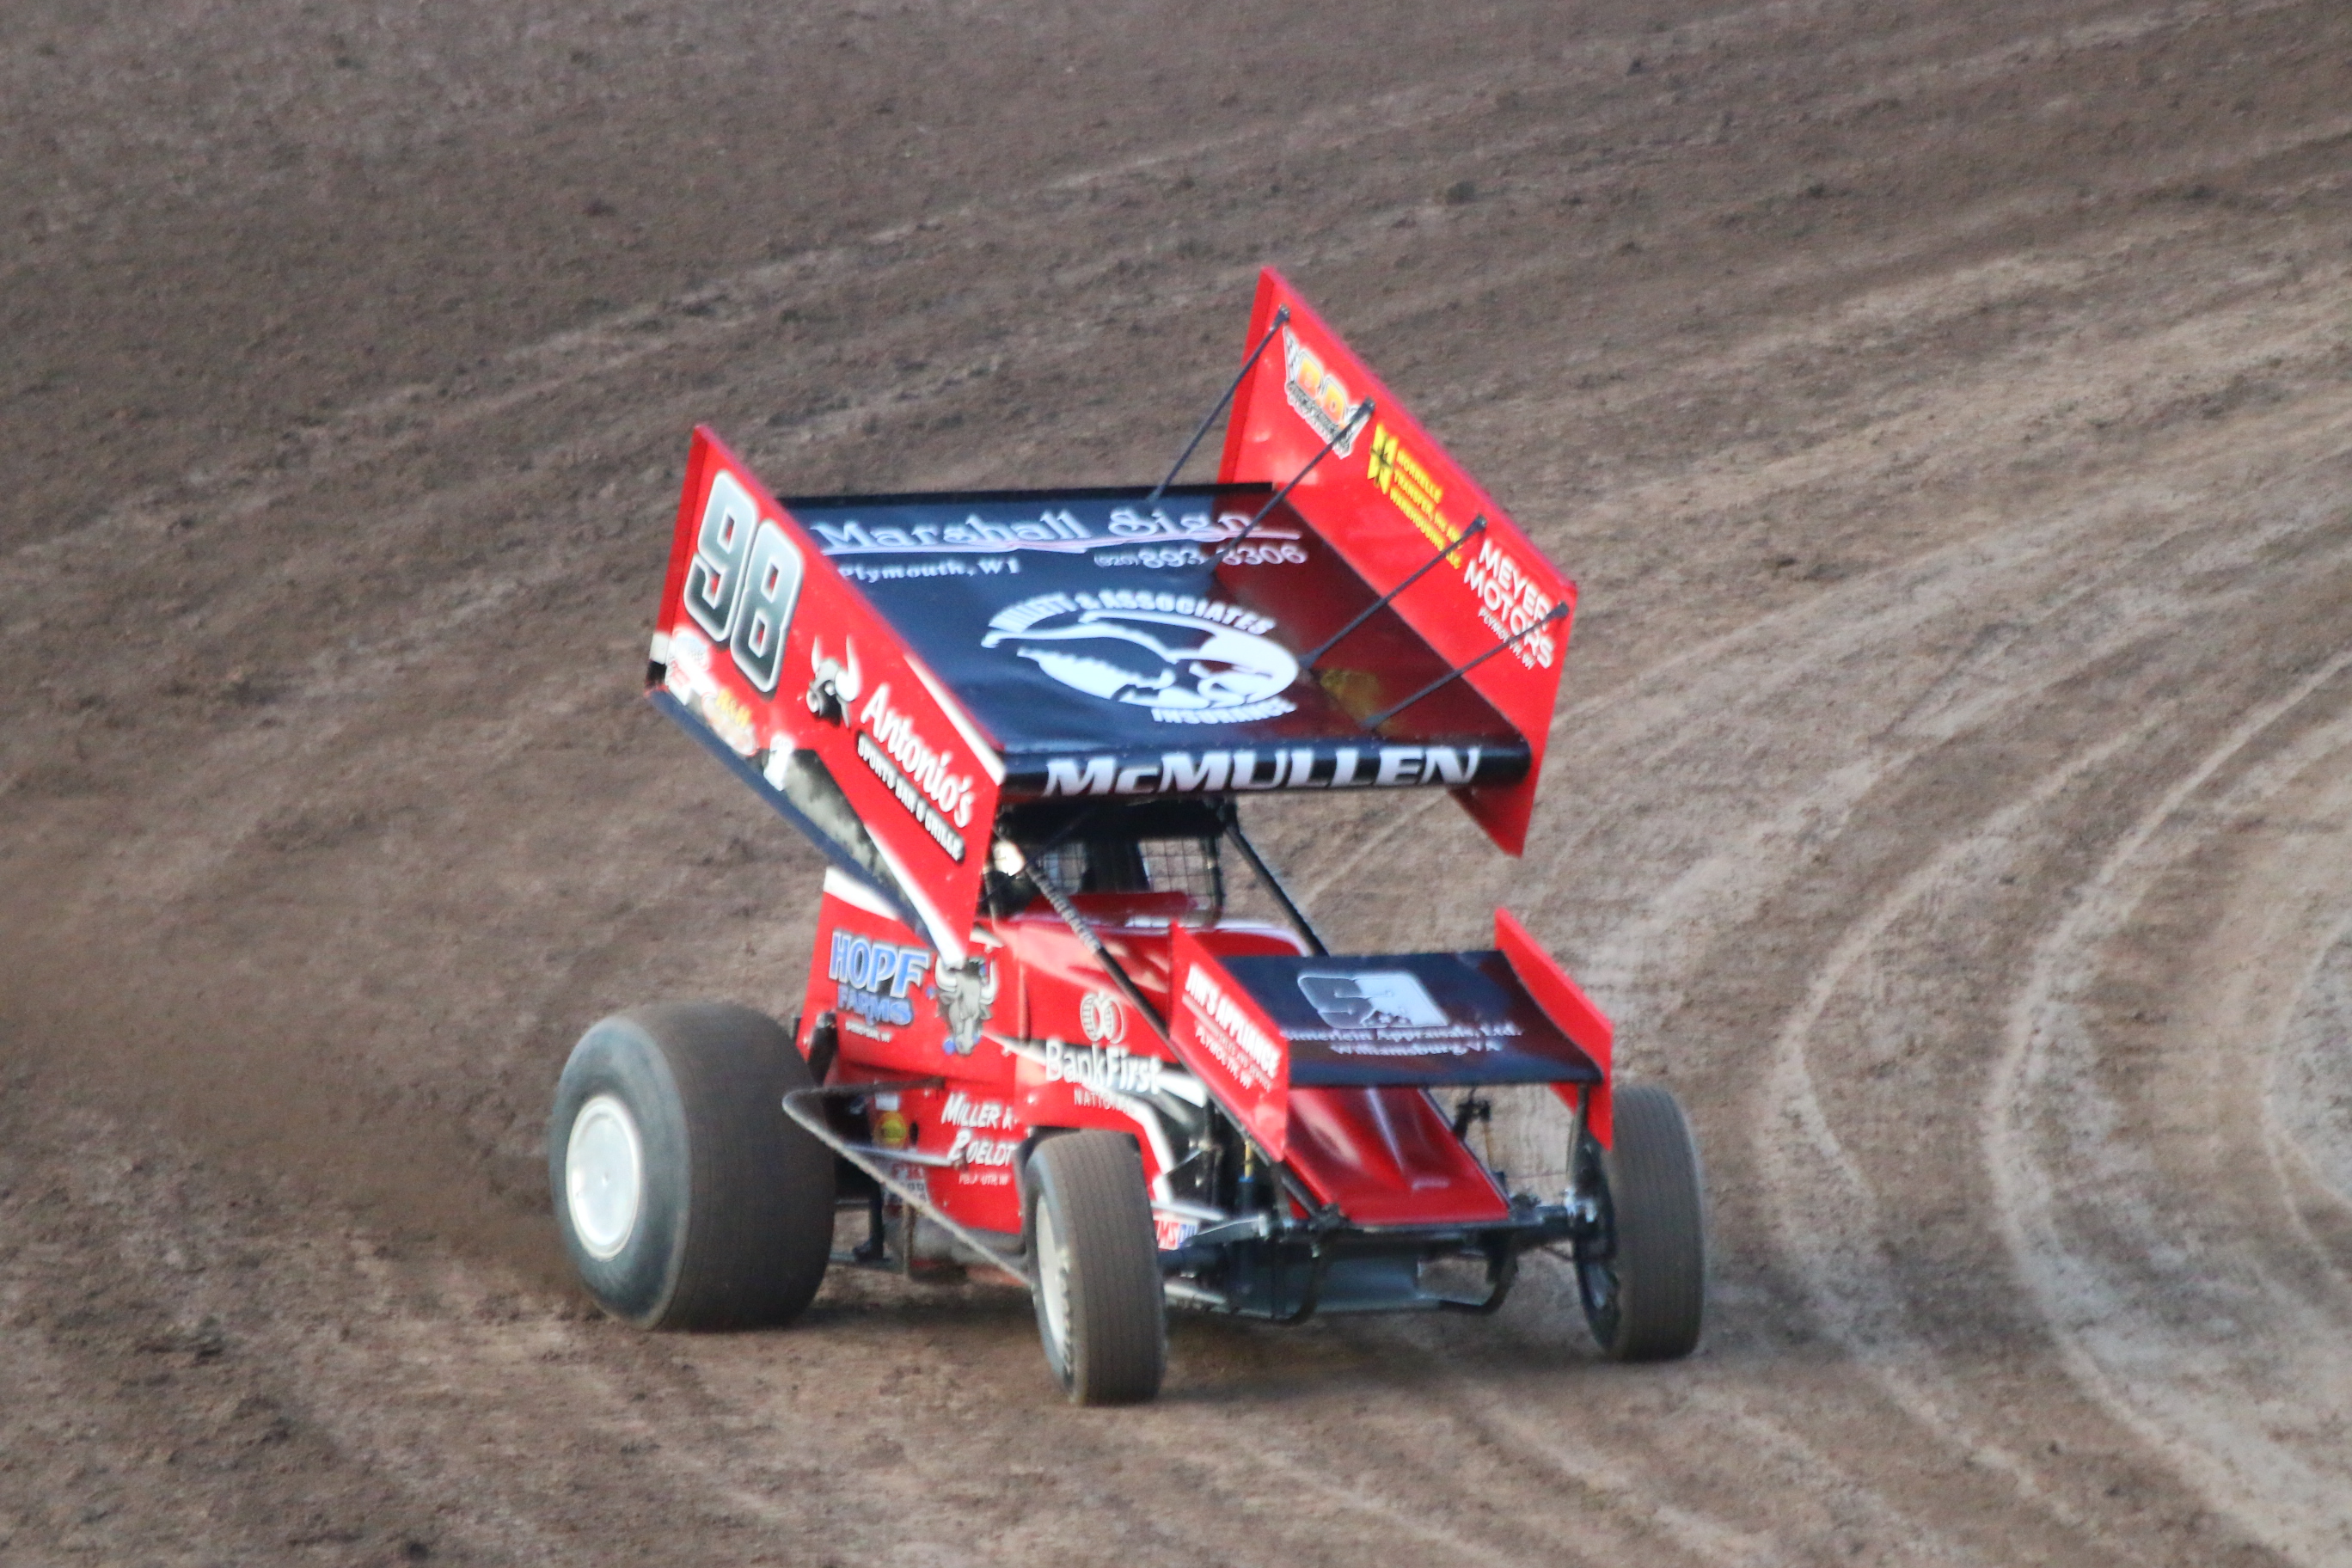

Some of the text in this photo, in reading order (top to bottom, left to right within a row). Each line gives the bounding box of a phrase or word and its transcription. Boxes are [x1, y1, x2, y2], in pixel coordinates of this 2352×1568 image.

[811, 510, 1091, 548] Marshall
[683, 469, 804, 693] 98
[1098, 589, 1277, 635] ASSOCIATES
[1464, 560, 1554, 669] MOTORS
[1478, 538, 1553, 632] MEYER
[857, 732, 898, 789] SPORTS
[895, 776, 918, 813] BAR
[861, 683, 974, 828] Antonio's
[1042, 746, 1481, 797] McMULLEN
[829, 929, 930, 998] HOPF
[837, 983, 914, 1026] FARMS
